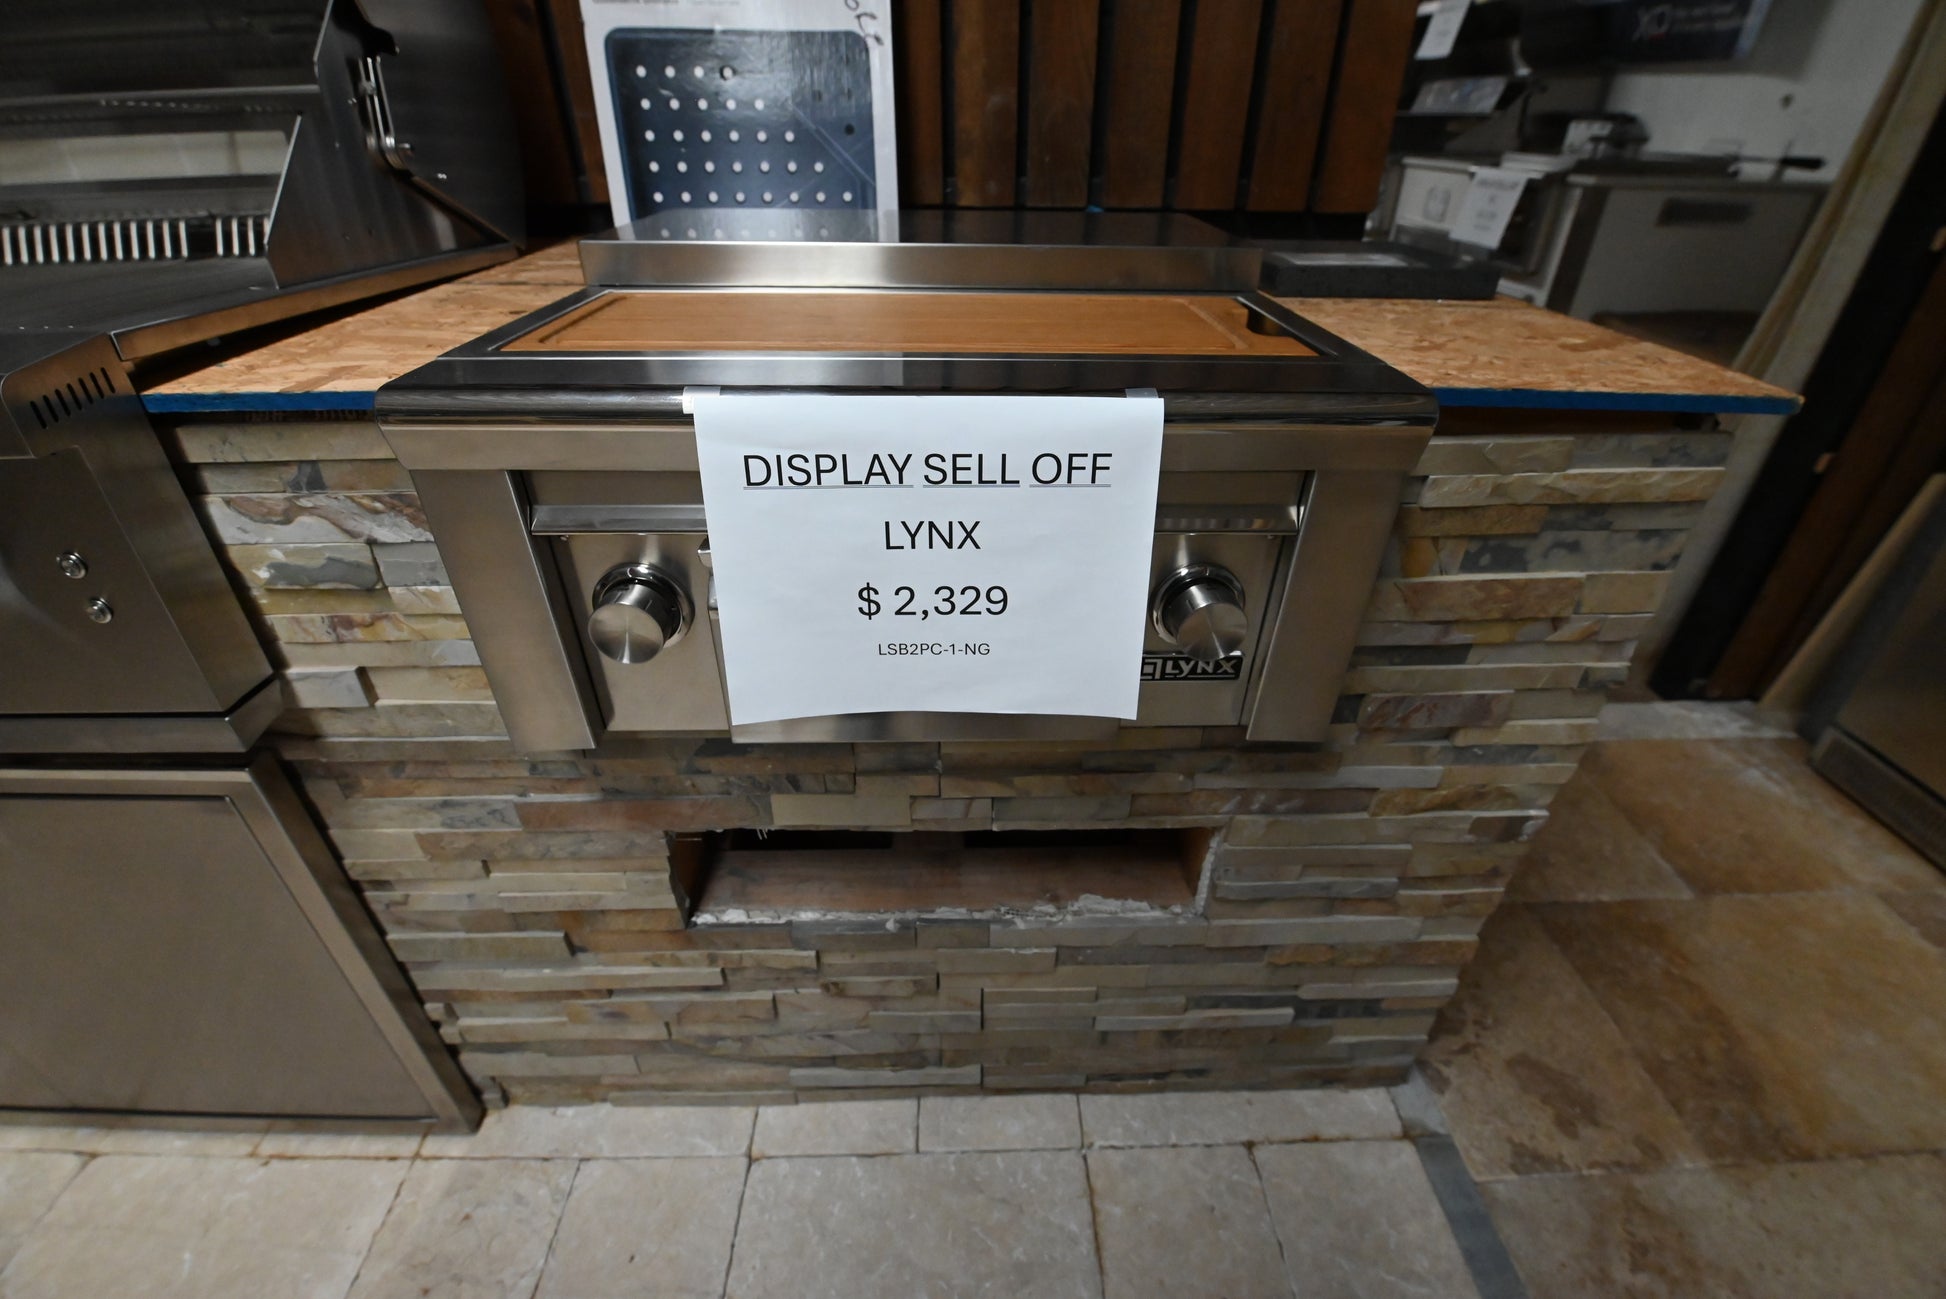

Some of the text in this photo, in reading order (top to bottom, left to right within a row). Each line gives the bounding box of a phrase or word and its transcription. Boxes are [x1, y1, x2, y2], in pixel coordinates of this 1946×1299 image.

[743, 452, 1113, 487] DISPLAY SELL OFF
[884, 520, 981, 550] LYNX
[857, 582, 1008, 621] $ 2,329
[878, 642, 990, 656] LSB2PC-1-NG
